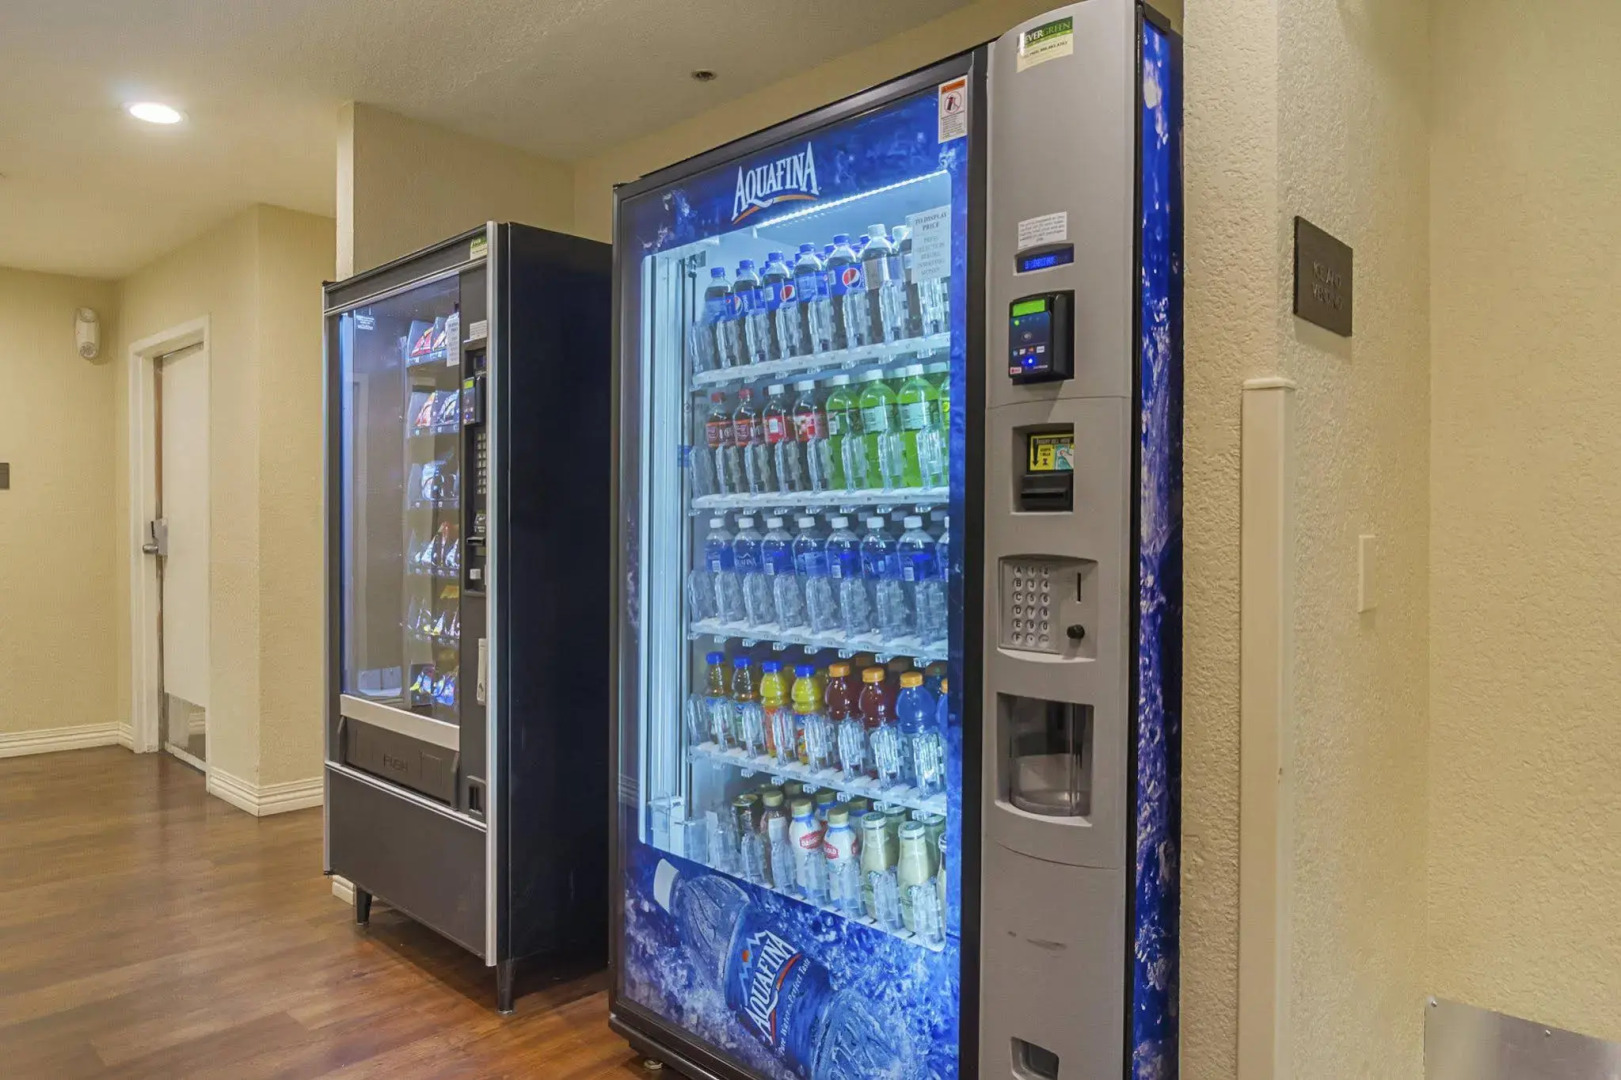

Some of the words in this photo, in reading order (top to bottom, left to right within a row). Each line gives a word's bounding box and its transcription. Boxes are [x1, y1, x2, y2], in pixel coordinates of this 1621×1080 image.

[731, 141, 820, 221] AQUAFINA
[922, 222, 939, 231] PRICE
[923, 212, 947, 224] DISPLAY
[383, 754, 408, 772] PUSH
[744, 930, 797, 1045] AQUAFINA
[781, 1010, 791, 1036] Water
[788, 974, 803, 1003] Perfect
